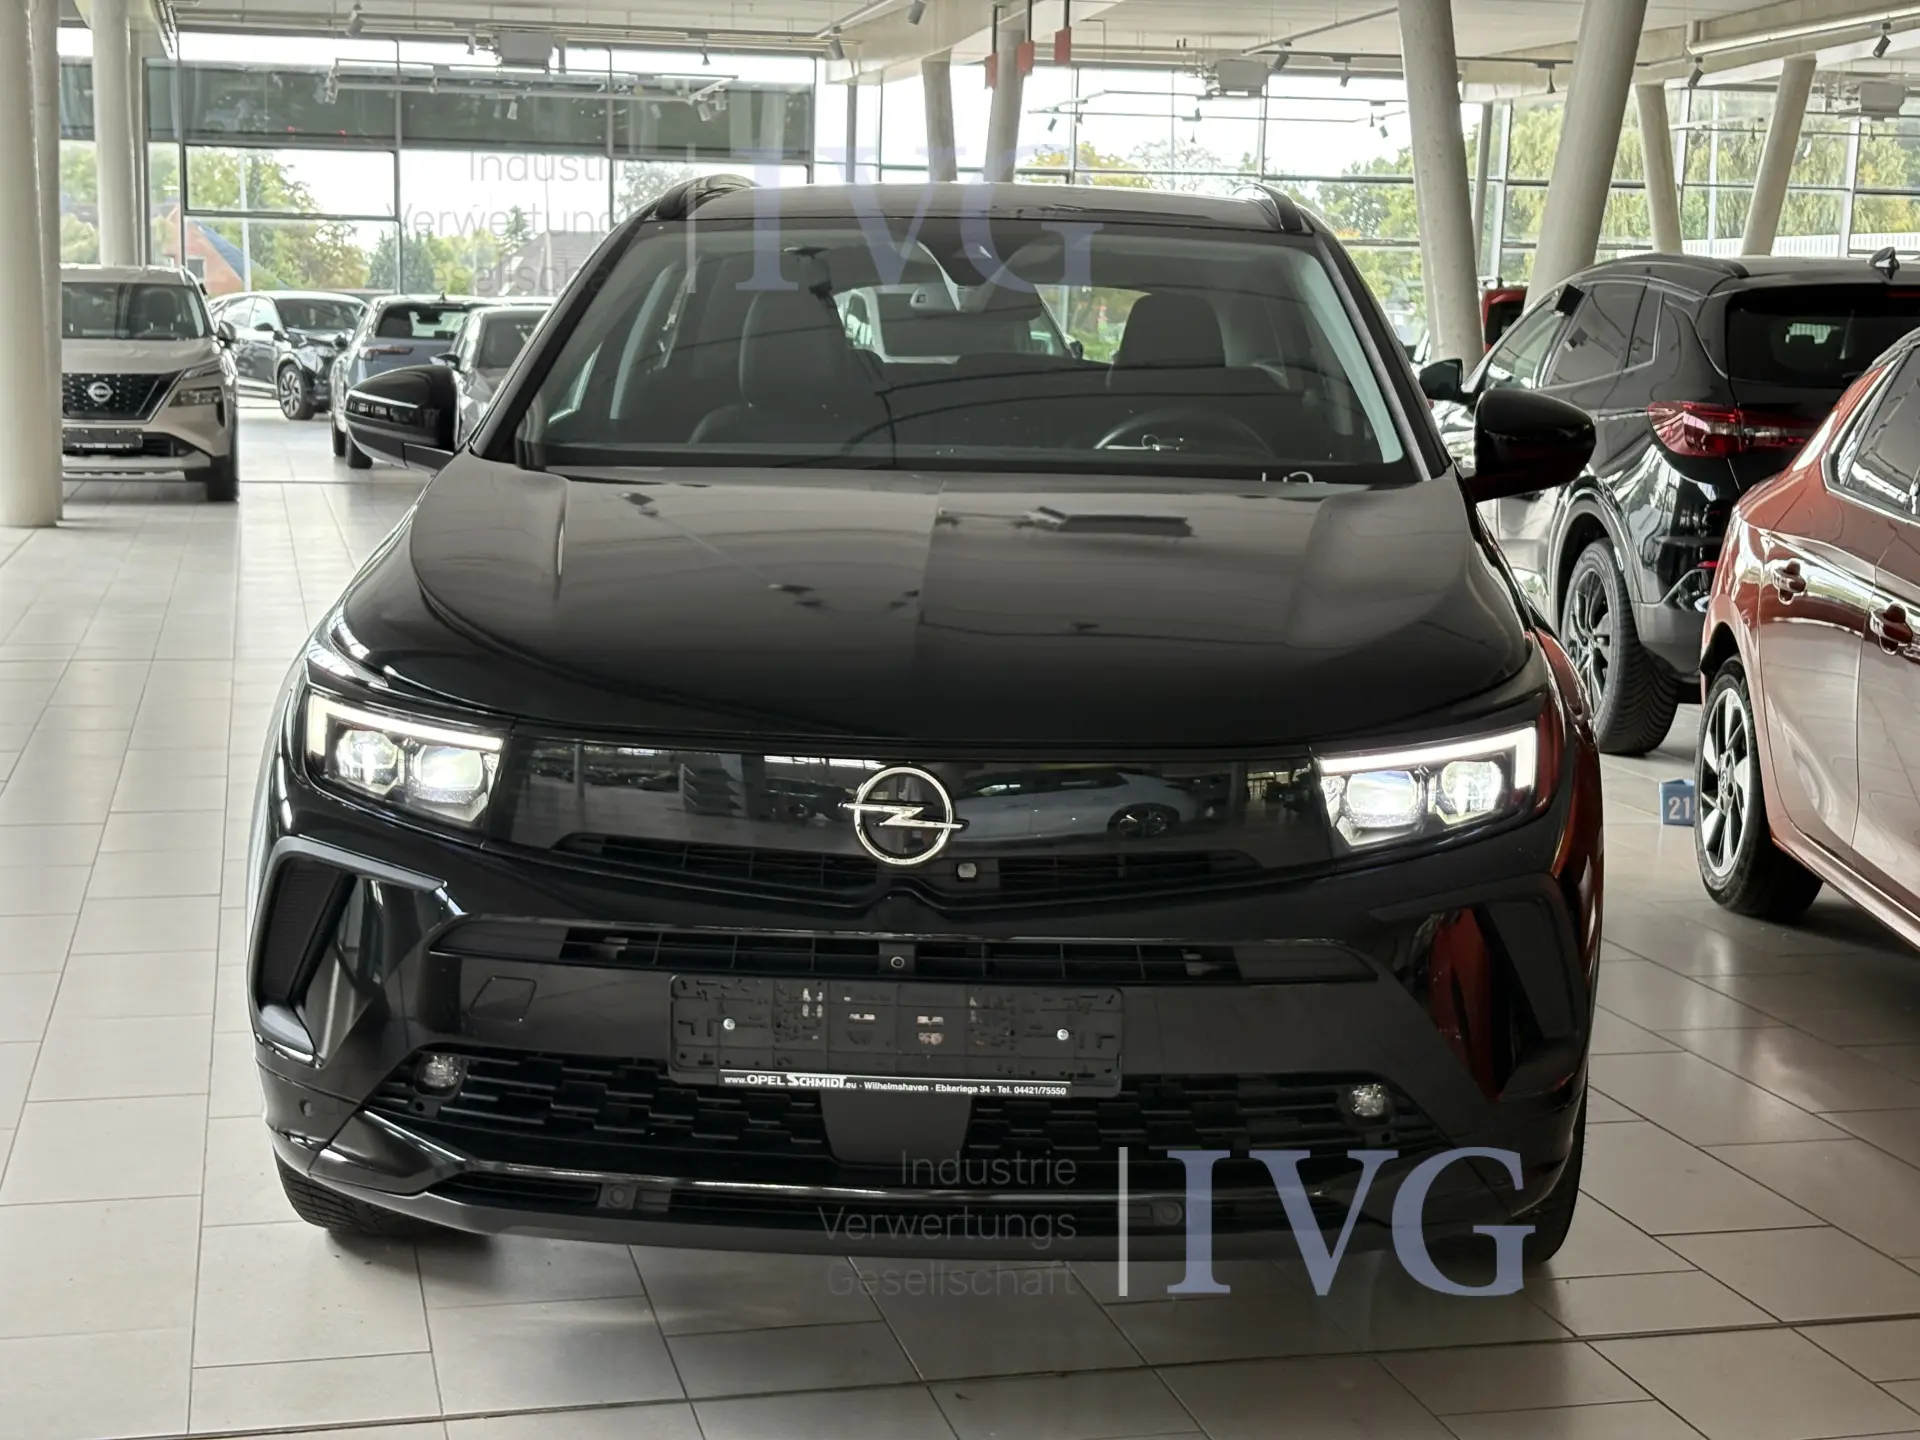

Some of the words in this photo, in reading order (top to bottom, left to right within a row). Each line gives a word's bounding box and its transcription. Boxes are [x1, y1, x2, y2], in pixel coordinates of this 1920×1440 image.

[1668, 796, 1690, 820] 21
[864, 1081, 929, 1092] Wilhelmshaven
[935, 1083, 978, 1094] Ebkeriege
[980, 1085, 991, 1093] 34
[997, 1085, 1012, 1094] Tel.
[1014, 1086, 1067, 1095] 04421/75550
